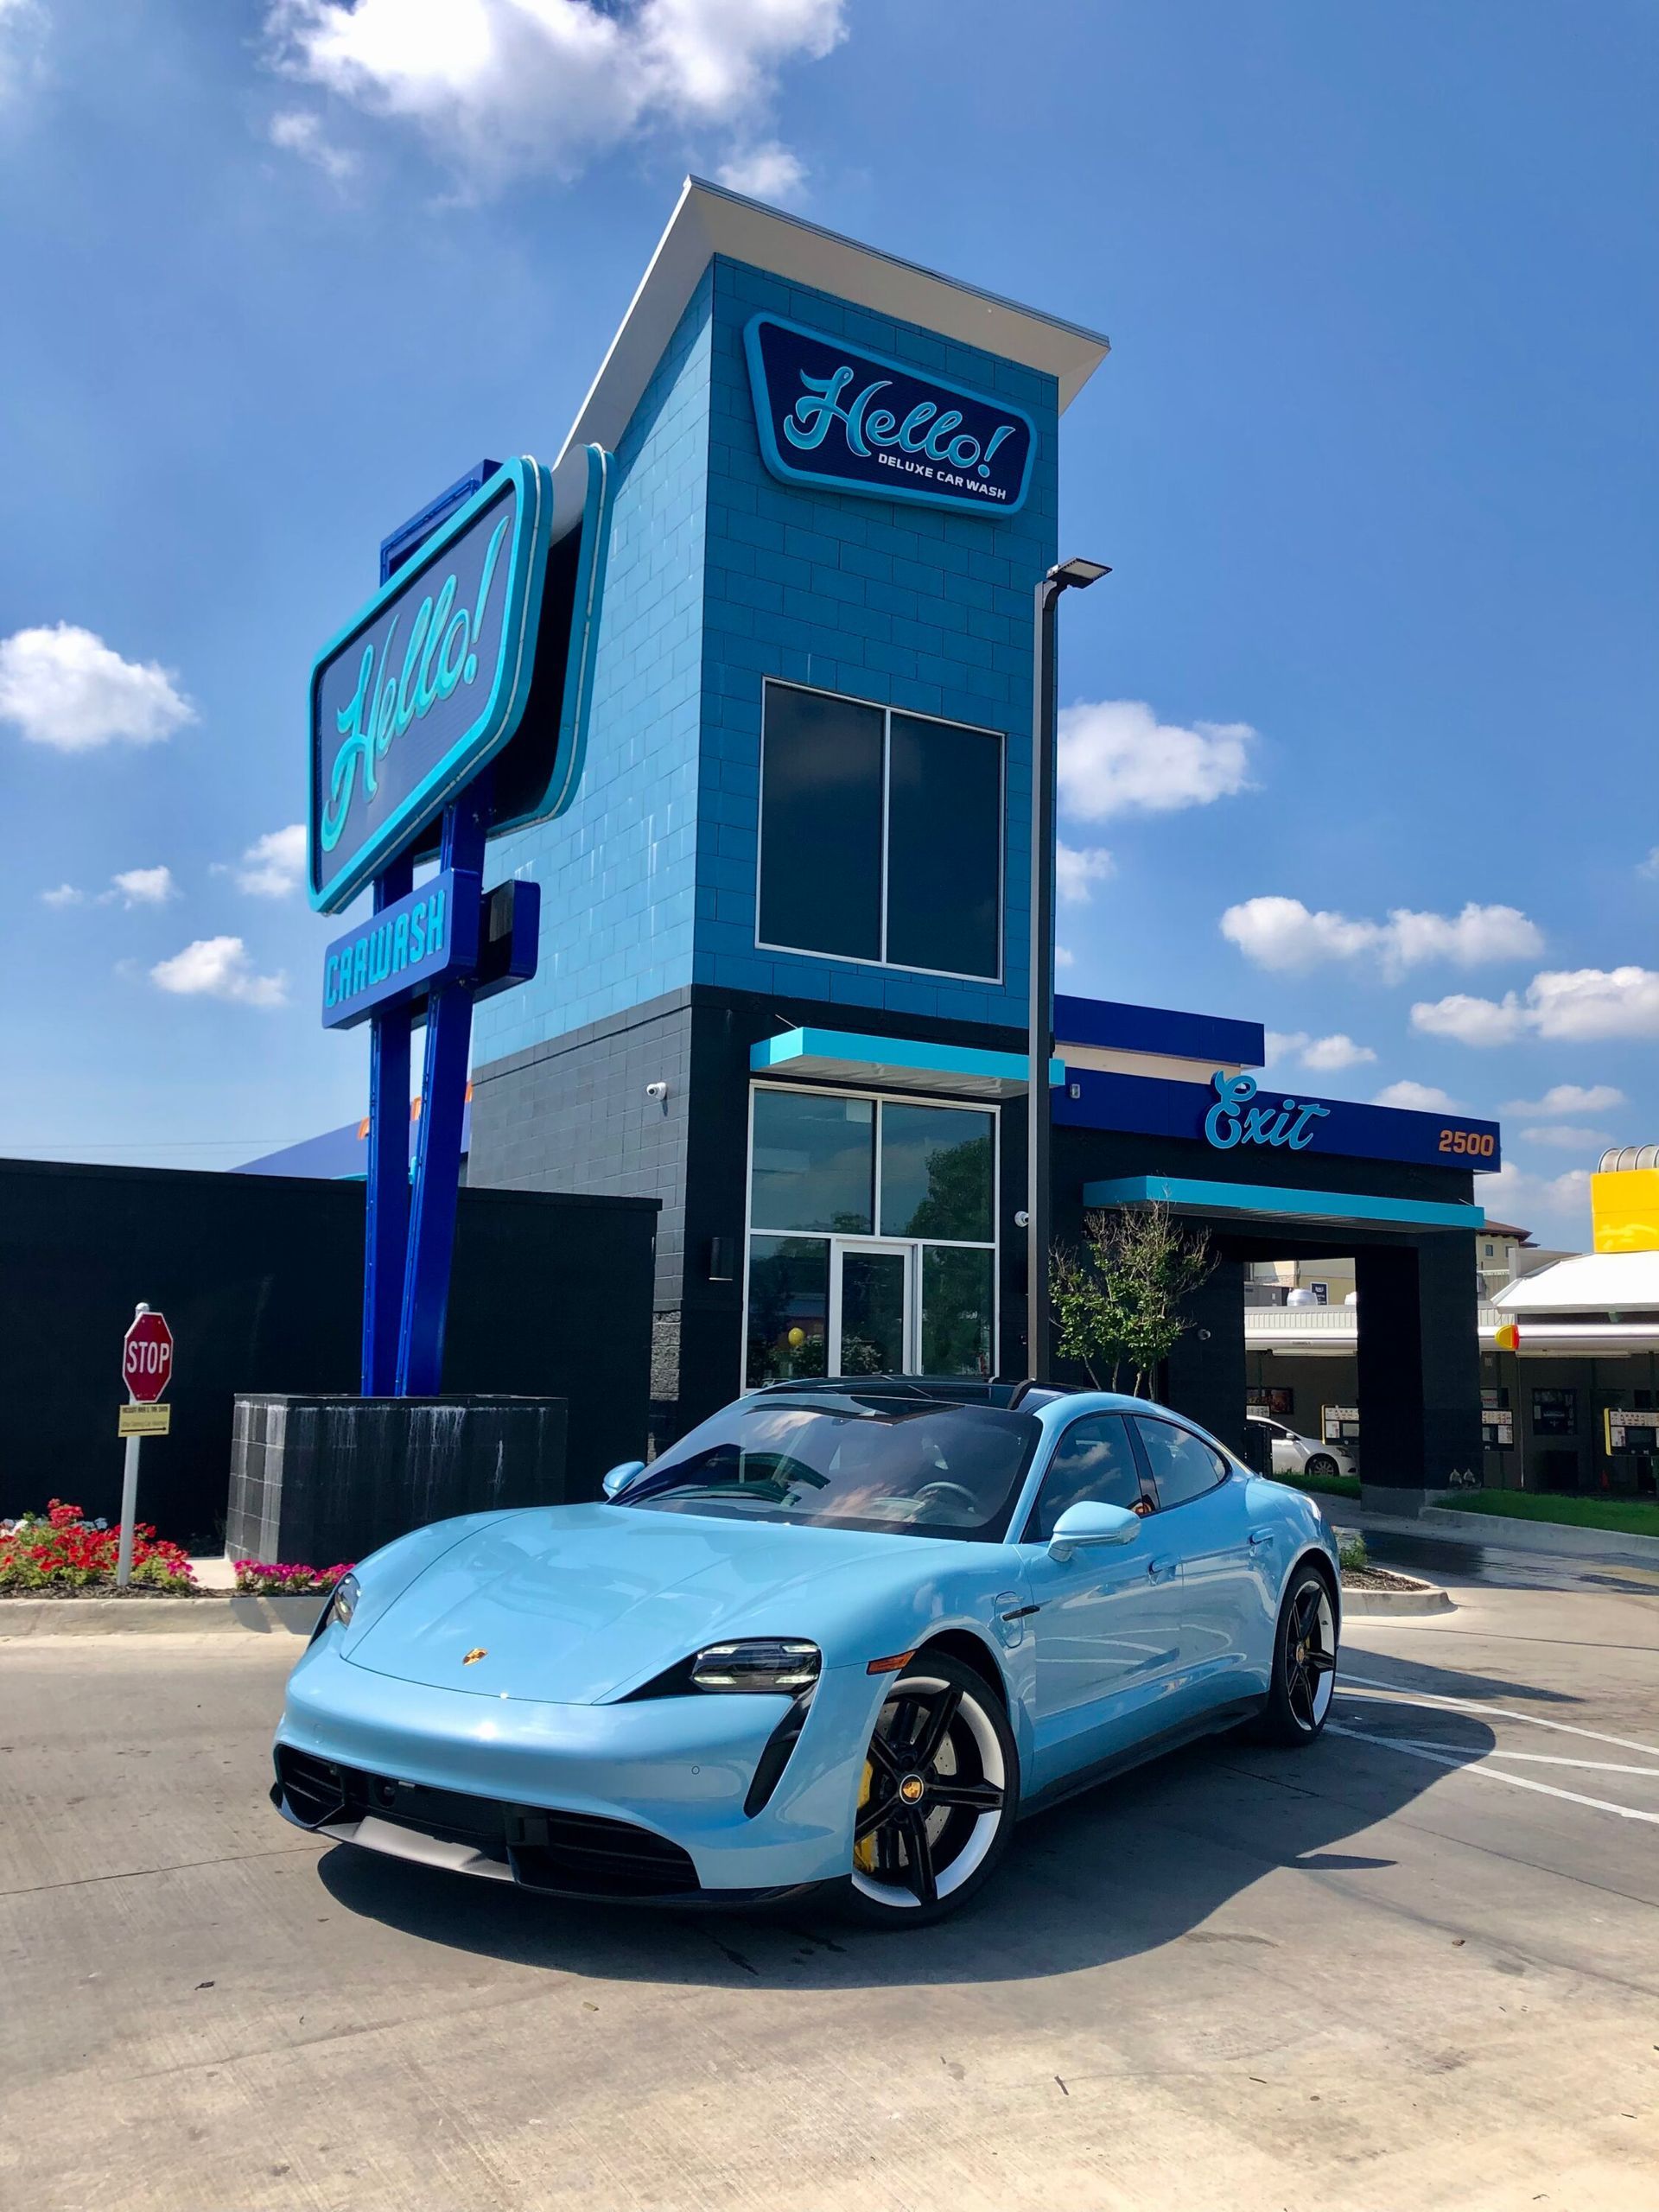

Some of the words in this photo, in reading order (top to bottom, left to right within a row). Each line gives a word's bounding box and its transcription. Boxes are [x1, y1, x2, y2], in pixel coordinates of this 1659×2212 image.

[784, 365, 1015, 478] Hello!
[878, 453, 934, 478] DELUXE
[937, 471, 963, 487] CAR
[966, 479, 1007, 499] WASH
[321, 516, 510, 852] Hello!
[325, 889, 446, 1008] CARWASH
[1205, 1070, 1331, 1150] Exit
[1438, 1129, 1495, 1157] 2500
[127, 1340, 170, 1375] STOP
